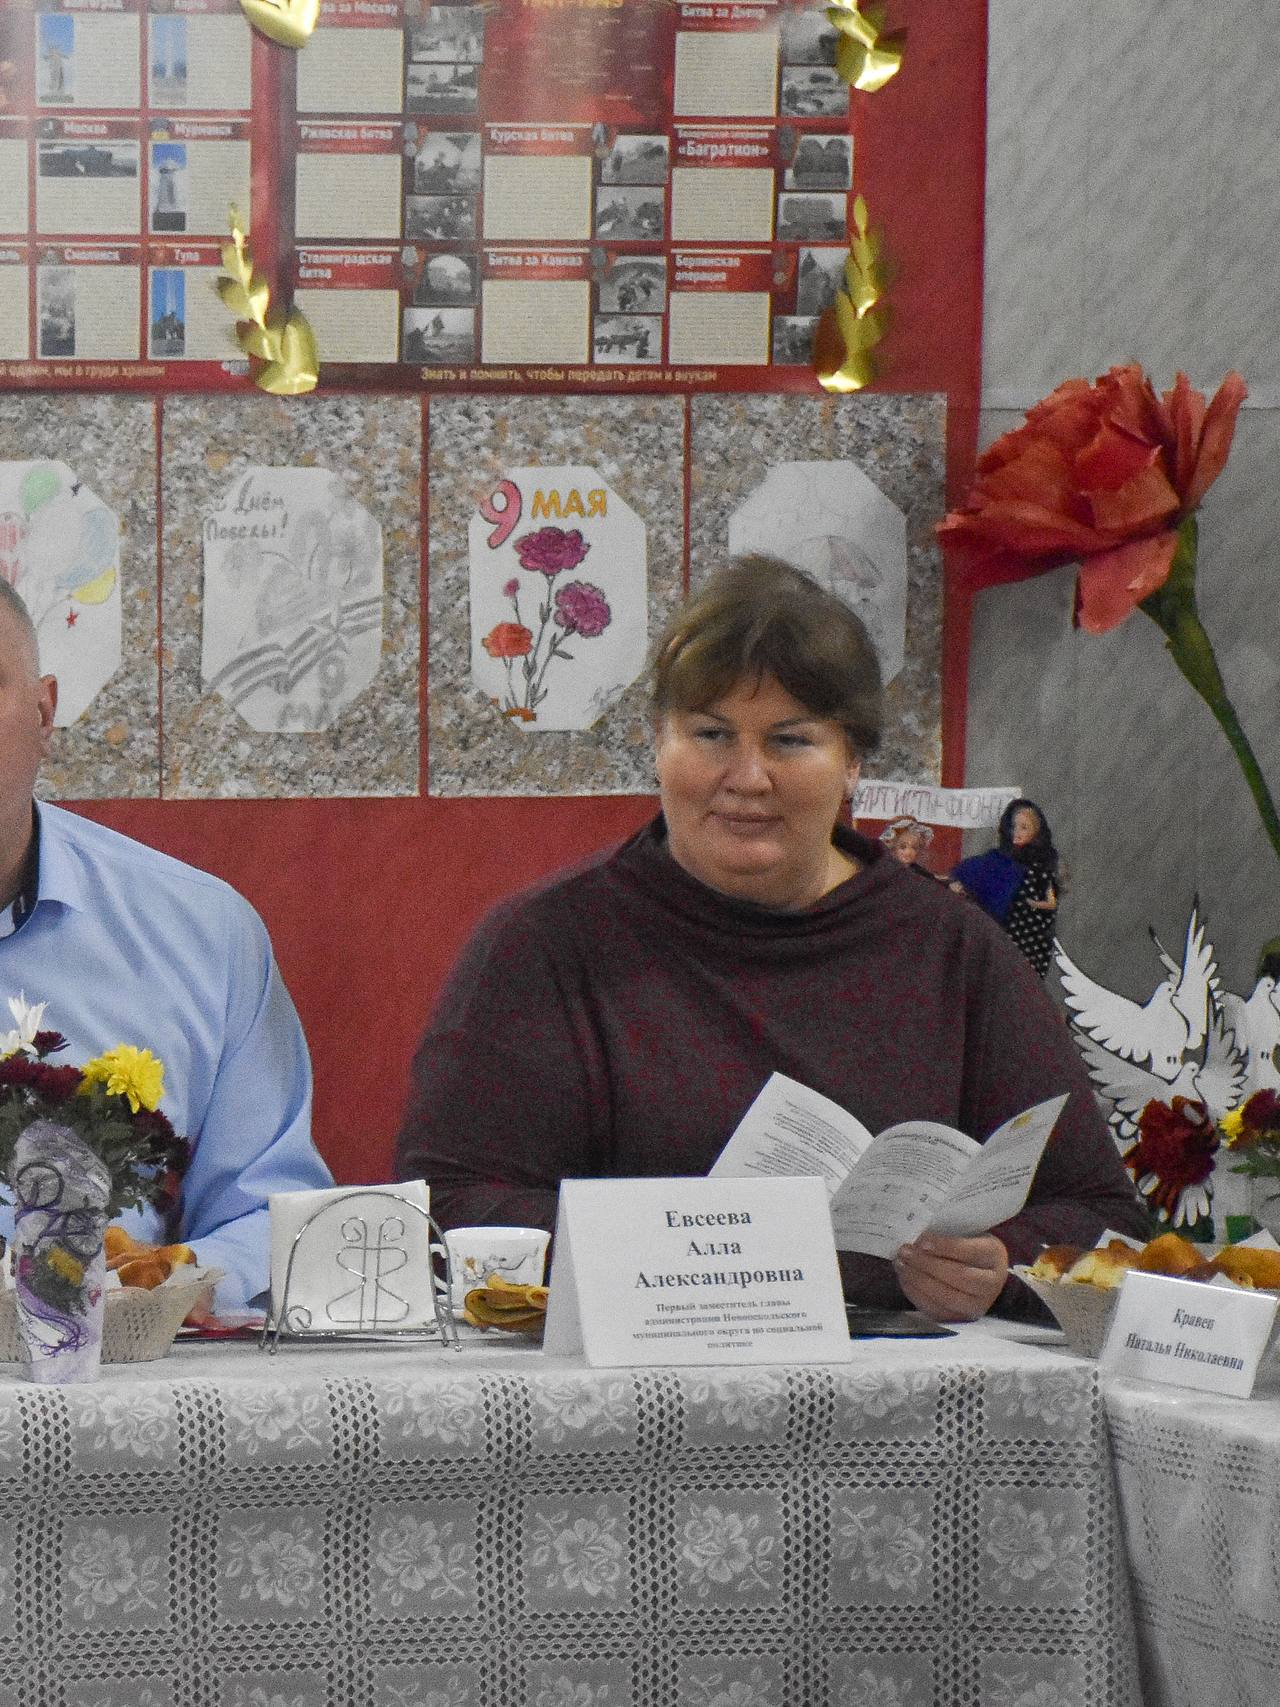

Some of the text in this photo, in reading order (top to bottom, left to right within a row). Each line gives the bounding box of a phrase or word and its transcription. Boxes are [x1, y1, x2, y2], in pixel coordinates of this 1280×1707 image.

[677, 140, 769, 160] «Багратион»
[479, 479, 607, 549] 9 МАЯ
[664, 1210, 752, 1228] Евсеева
[686, 1240, 742, 1257] Алла
[634, 1267, 804, 1289] Александровна
[655, 1299, 791, 1314] Первый заместитель главы
[644, 1315, 721, 1326] администрации
[1173, 1308, 1216, 1330] Кравец
[717, 1326, 751, 1338] округа
[1124, 1333, 1244, 1371] Наталья Николаевна
